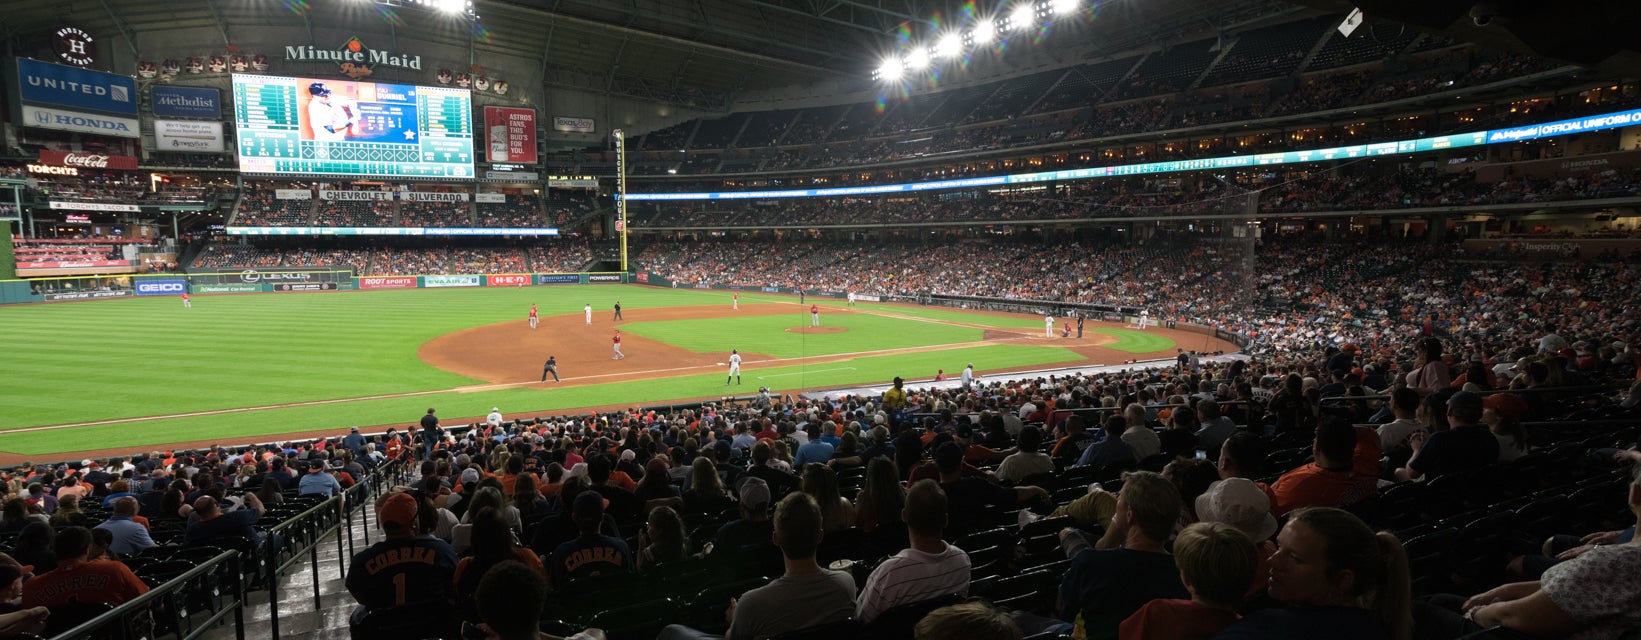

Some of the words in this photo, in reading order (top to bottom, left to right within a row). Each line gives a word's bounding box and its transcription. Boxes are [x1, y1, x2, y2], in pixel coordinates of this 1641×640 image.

[57, 27, 93, 42] HOUSTON
[69, 39, 86, 55] H
[61, 53, 93, 65] ASTROS
[285, 45, 364, 62] Minute
[369, 49, 422, 70] Maid
[28, 75, 107, 96] UNITED
[157, 95, 215, 108] Methodist
[56, 114, 130, 132] HONDA
[509, 113, 533, 121] ASTROS
[578, 119, 593, 128] Bay
[1542, 122, 1582, 135] OFFICIAL
[1583, 113, 1631, 129] UNIFORM
[64, 153, 110, 168] Coca-Cola
[1570, 158, 1608, 167] HONDA
[326, 191, 386, 200] CHEVROLET
[409, 193, 462, 201] SILVERADO
[1526, 242, 1560, 252] Insperity
[139, 282, 183, 292] GEICO
[364, 547, 435, 576] CORREA
[564, 547, 622, 573] CORREA
[392, 572, 406, 605] 1
